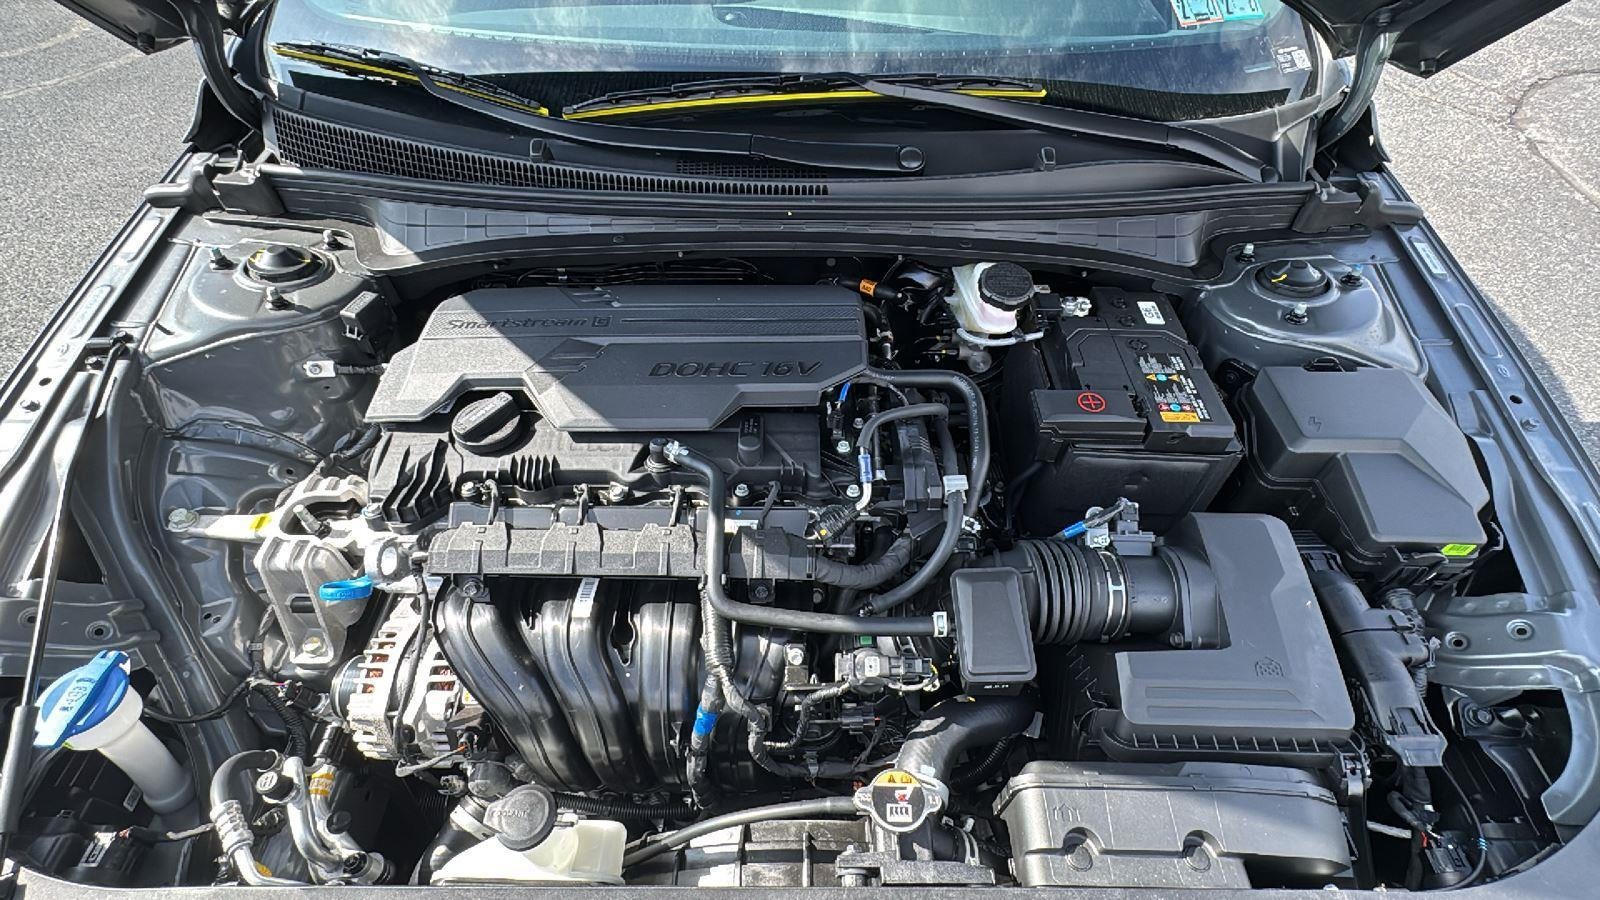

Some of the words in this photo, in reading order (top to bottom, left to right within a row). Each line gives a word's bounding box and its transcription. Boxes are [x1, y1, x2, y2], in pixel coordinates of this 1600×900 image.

[449, 317, 588, 329] Smartstream
[648, 360, 754, 378] DOHC
[761, 359, 822, 377] 16V
